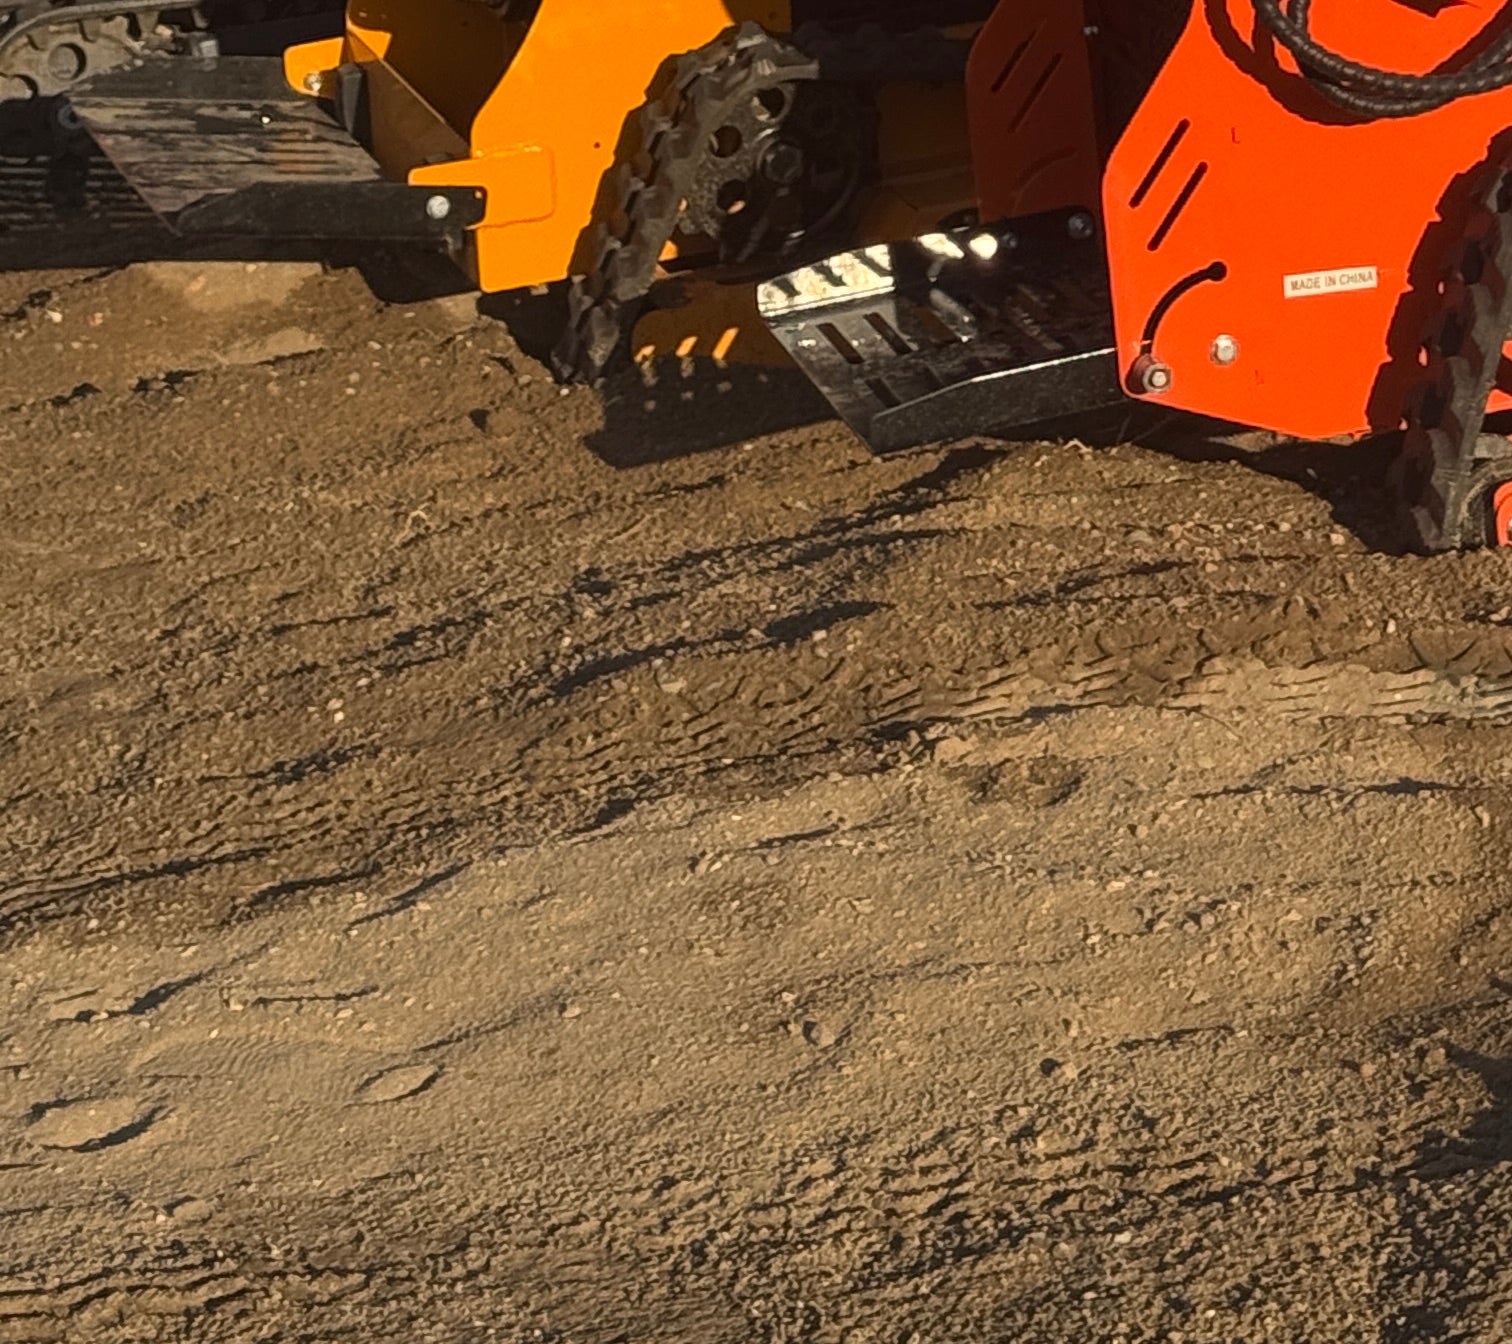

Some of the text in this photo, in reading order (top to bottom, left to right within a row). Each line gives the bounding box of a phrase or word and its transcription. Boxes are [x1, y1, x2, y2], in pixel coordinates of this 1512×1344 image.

[1290, 271, 1373, 291] MADE IN CHINA
